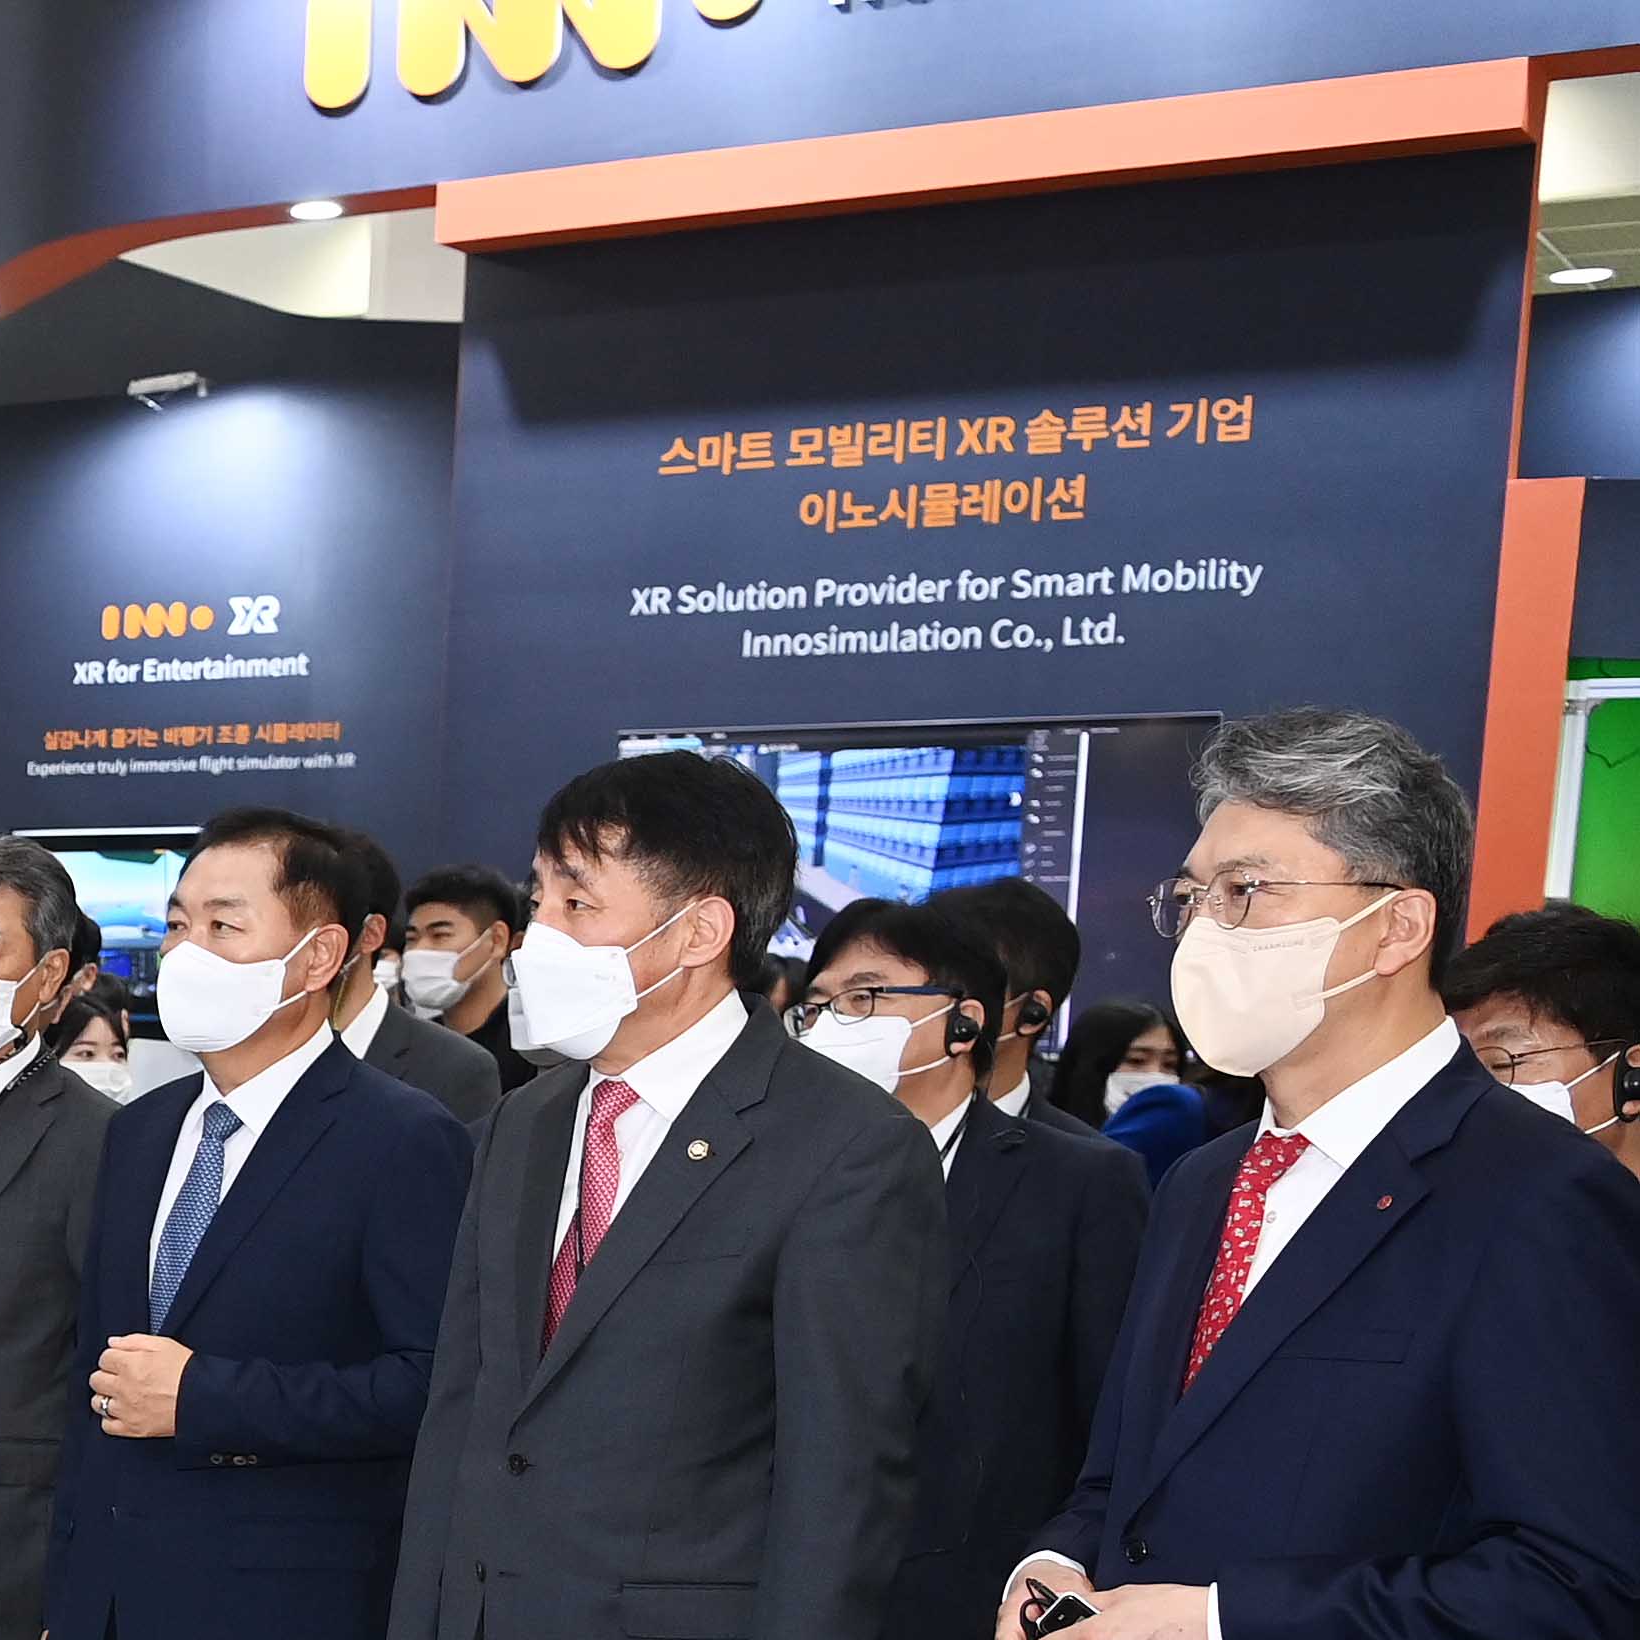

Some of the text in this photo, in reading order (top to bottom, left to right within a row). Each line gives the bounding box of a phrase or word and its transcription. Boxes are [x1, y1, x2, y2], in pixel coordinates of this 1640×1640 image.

[657, 393, 1254, 475] 스마트 모빌리티 XR 솔루션 기업
[799, 473, 1087, 534] 이노시뮬레이션
[629, 558, 1264, 616] XR Solution Provider for Smart Mobility
[741, 612, 1126, 658] Innosimulation Co., Ltd.
[73, 653, 309, 684] XR for Entertainment
[112, 728, 159, 748] 즐기는
[163, 725, 213, 746] 비행기
[27, 759, 95, 778] Experience
[97, 758, 127, 777] truly
[129, 757, 197, 775] immersive
[236, 754, 299, 770] simulator
[301, 753, 334, 768] with
